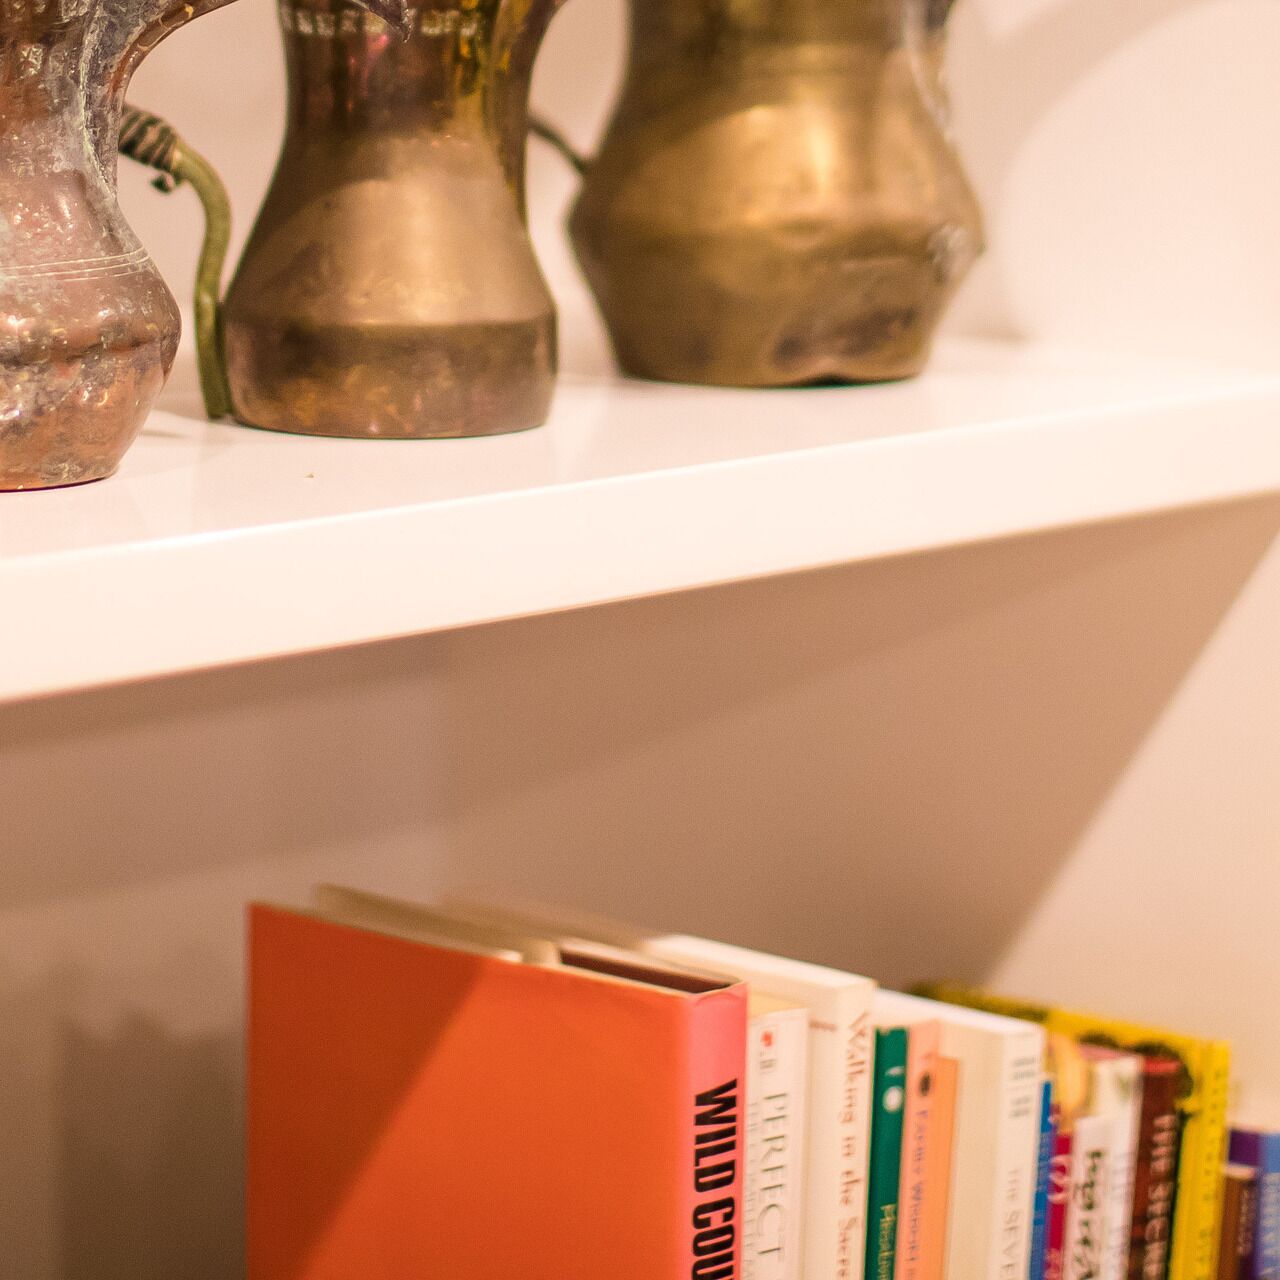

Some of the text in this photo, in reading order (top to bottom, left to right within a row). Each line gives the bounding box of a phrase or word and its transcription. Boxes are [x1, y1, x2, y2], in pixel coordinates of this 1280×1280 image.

[837, 1011, 870, 1126] Walking
[693, 1077, 738, 1194] WILD
[756, 1092, 788, 1263] PERFECT
[841, 1135, 857, 1158] in
[838, 1169, 862, 1208] the
[999, 1208, 1023, 1280] SEVE
